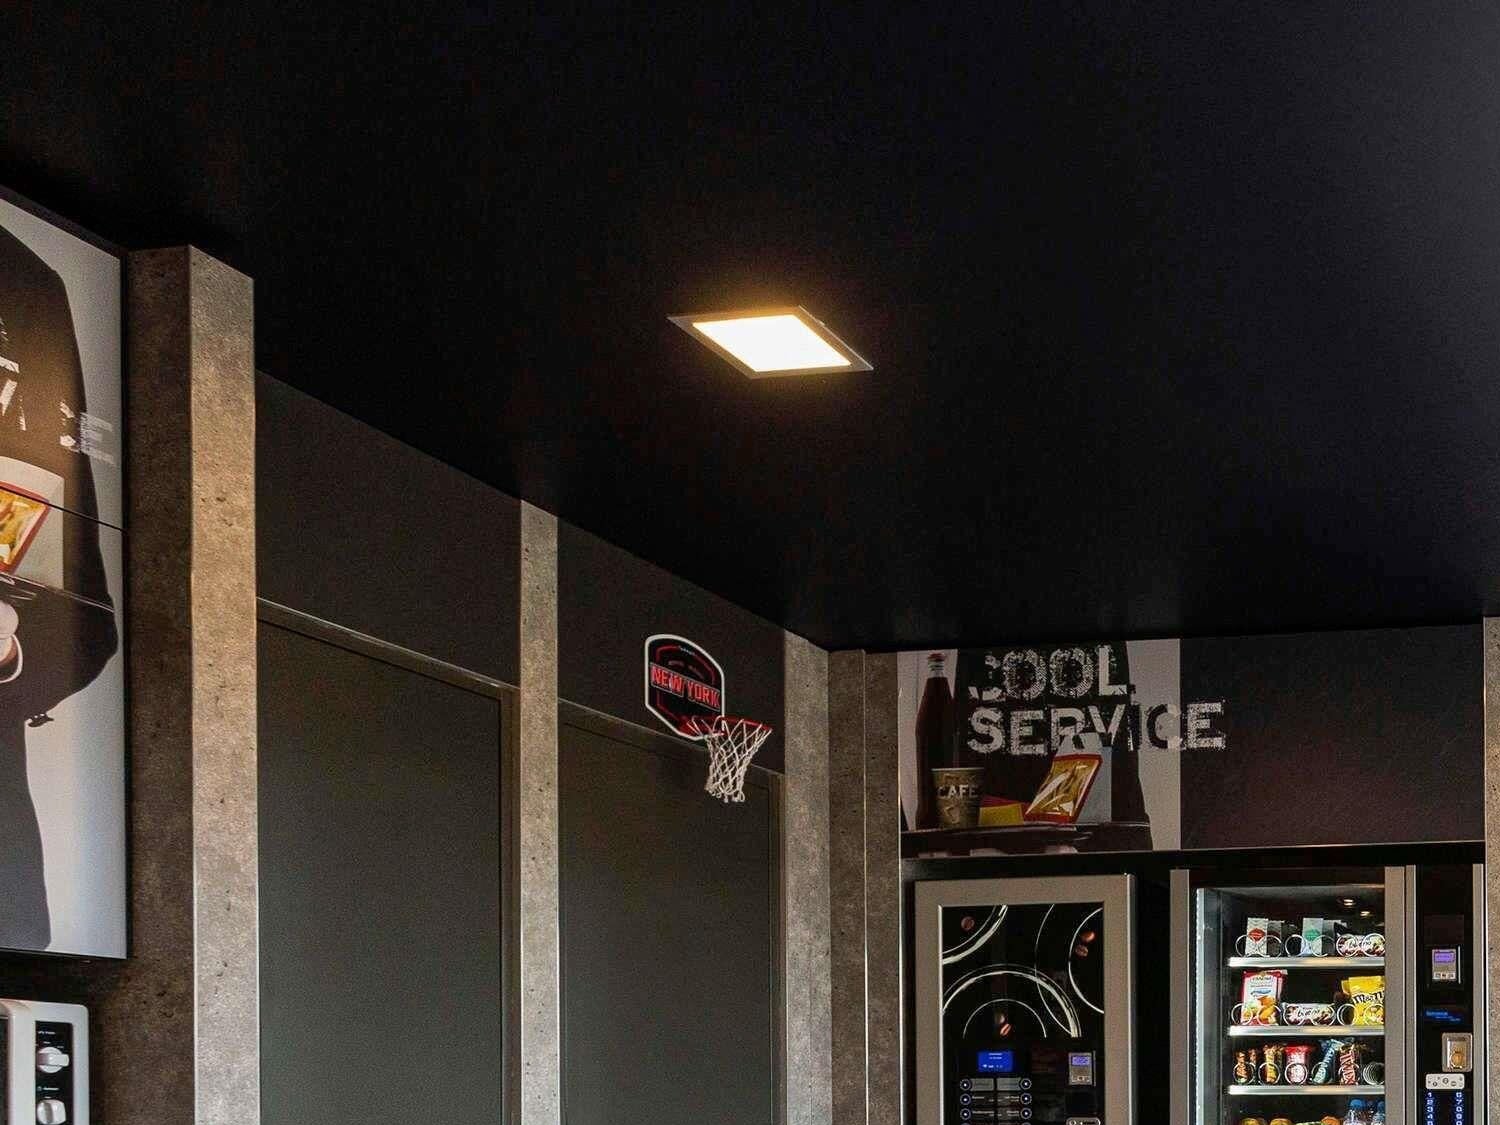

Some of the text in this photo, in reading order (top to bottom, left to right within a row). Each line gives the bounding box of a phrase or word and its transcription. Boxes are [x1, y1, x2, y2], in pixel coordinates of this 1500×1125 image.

[651, 666, 721, 708] NEW YORK
[967, 698, 1228, 756] SERVICE
